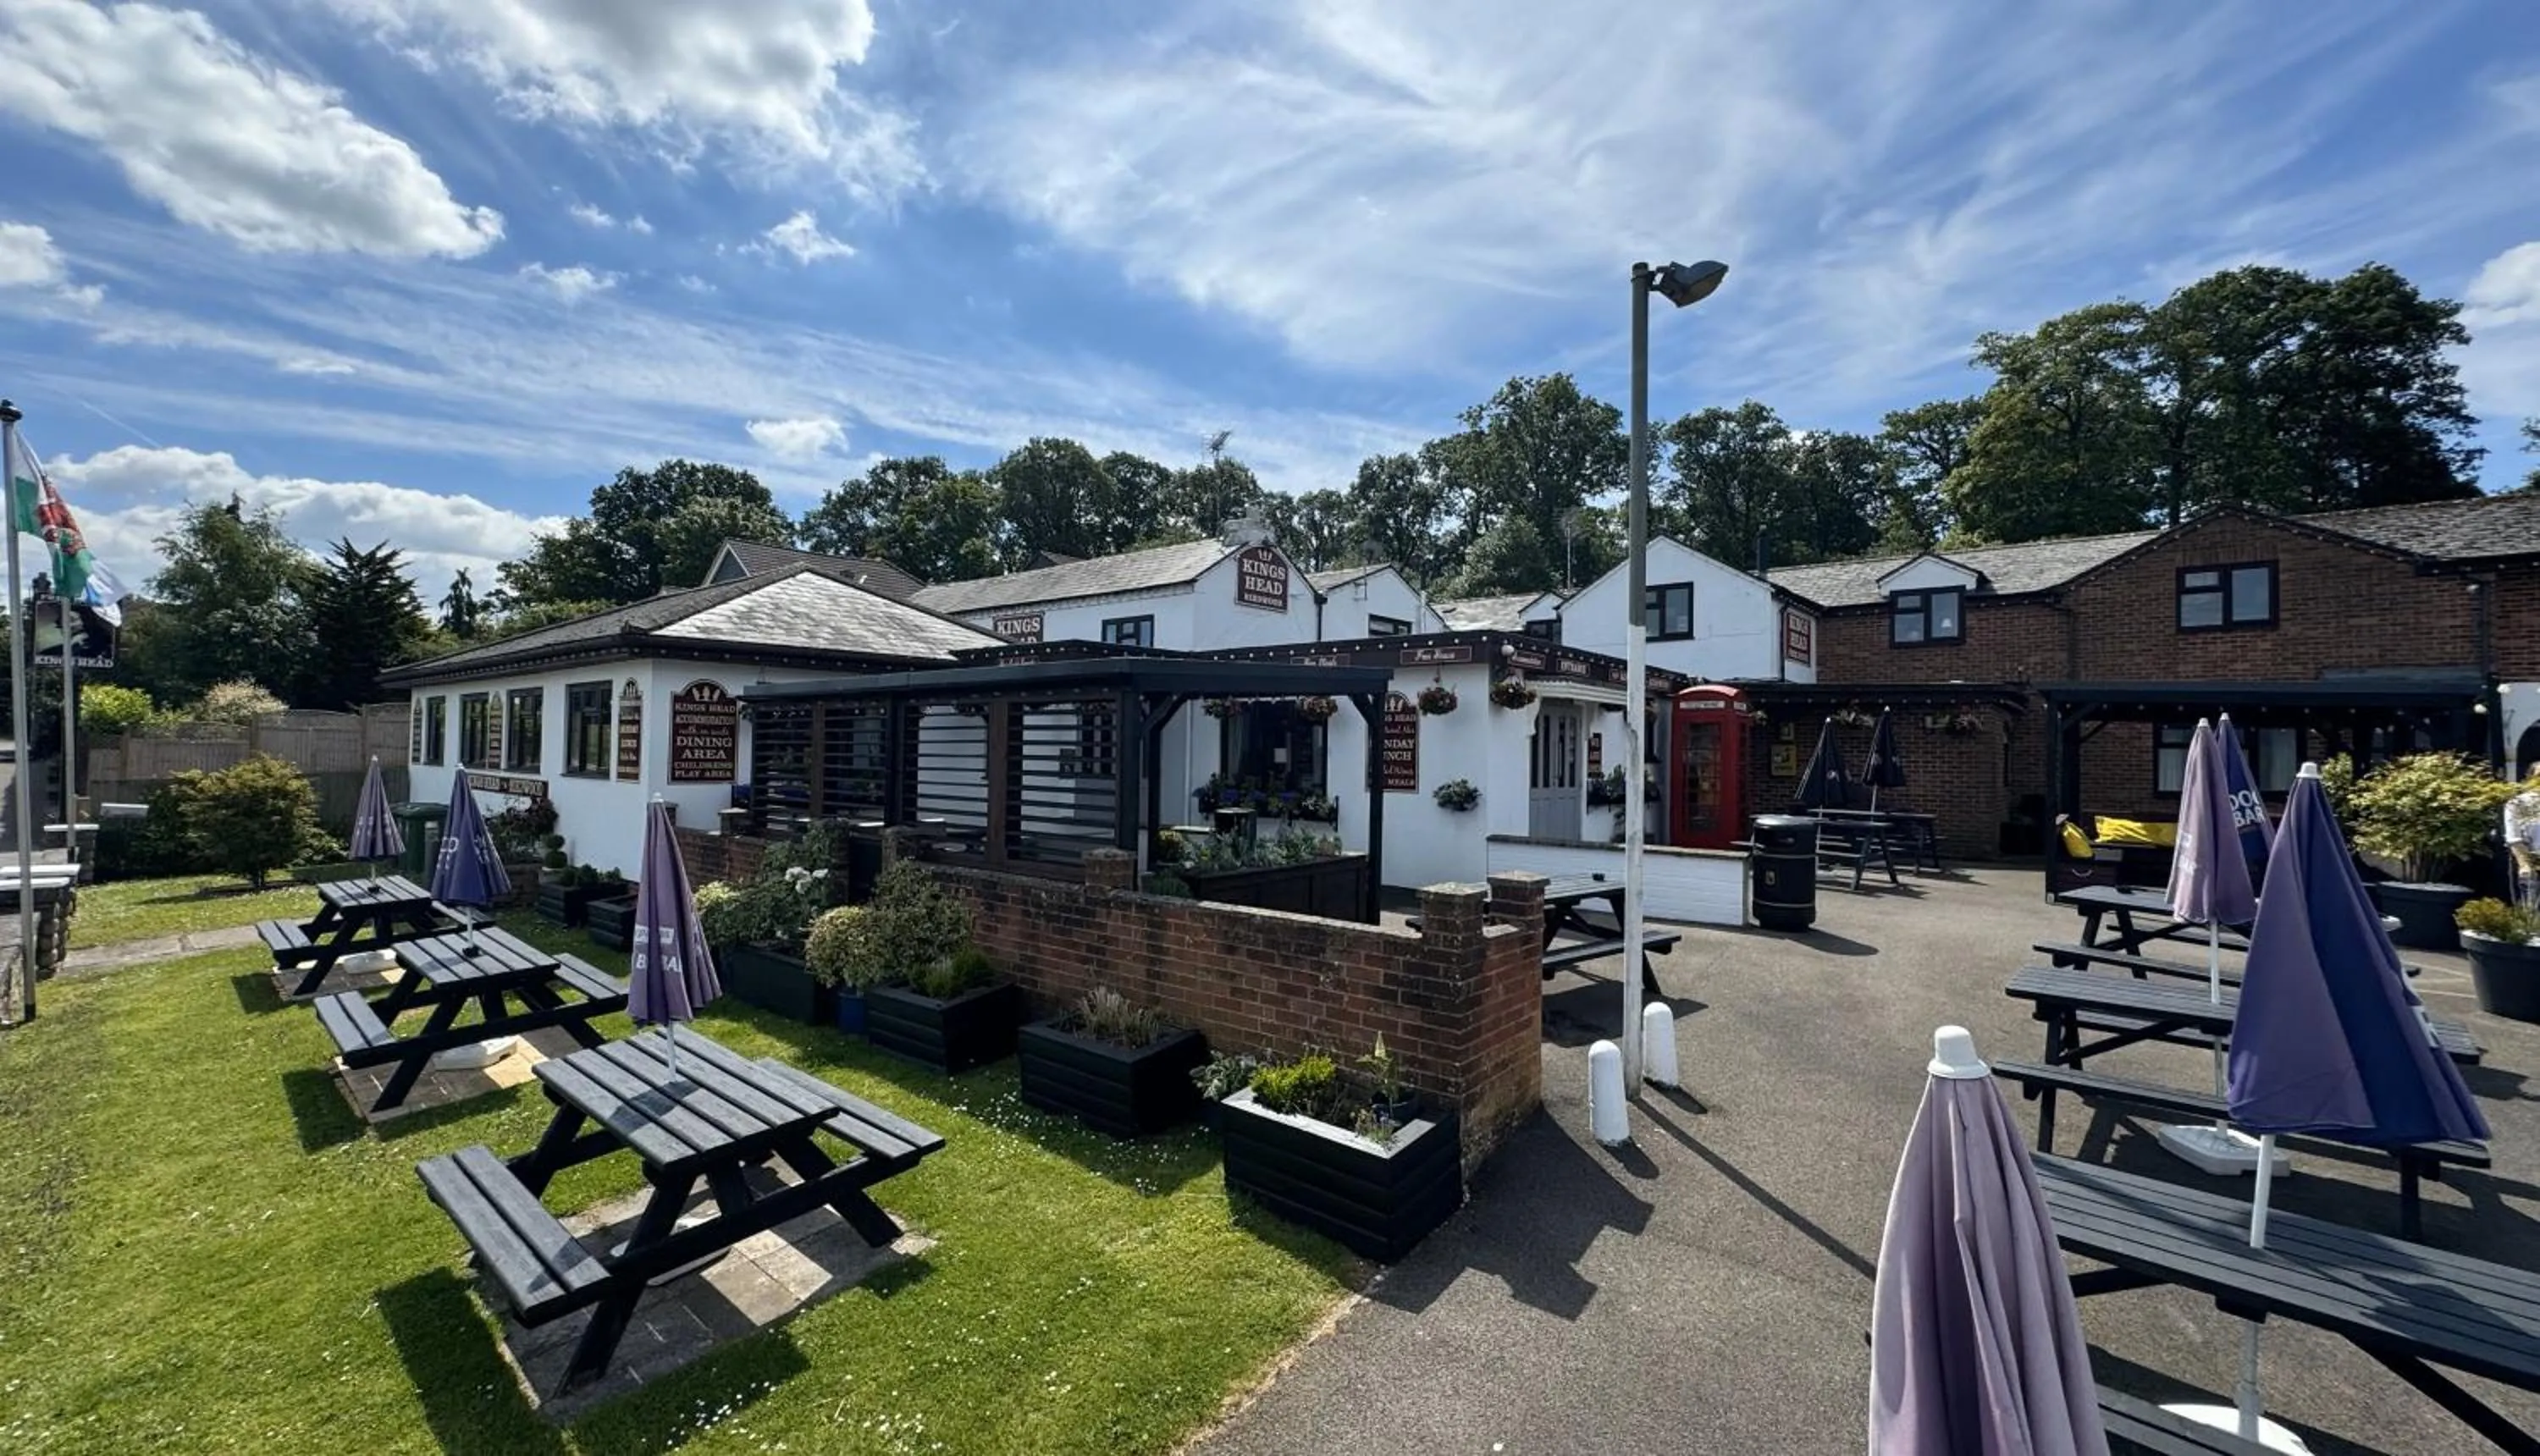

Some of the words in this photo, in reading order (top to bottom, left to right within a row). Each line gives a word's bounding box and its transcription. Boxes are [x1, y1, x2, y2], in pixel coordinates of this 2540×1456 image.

[1243, 559, 1285, 579] KINGS
[1245, 576, 1283, 594] HEAD
[997, 618, 1041, 634] KINGS
[78, 657, 113, 668] HEAD
[709, 704, 735, 713] HEAD
[676, 736, 732, 747] DINING
[1384, 739, 1415, 749] NDAY
[682, 748, 726, 759] AREA
[1383, 751, 1412, 761] NCH
[675, 769, 702, 778] PLAY
[2233, 805, 2266, 828] BAR
